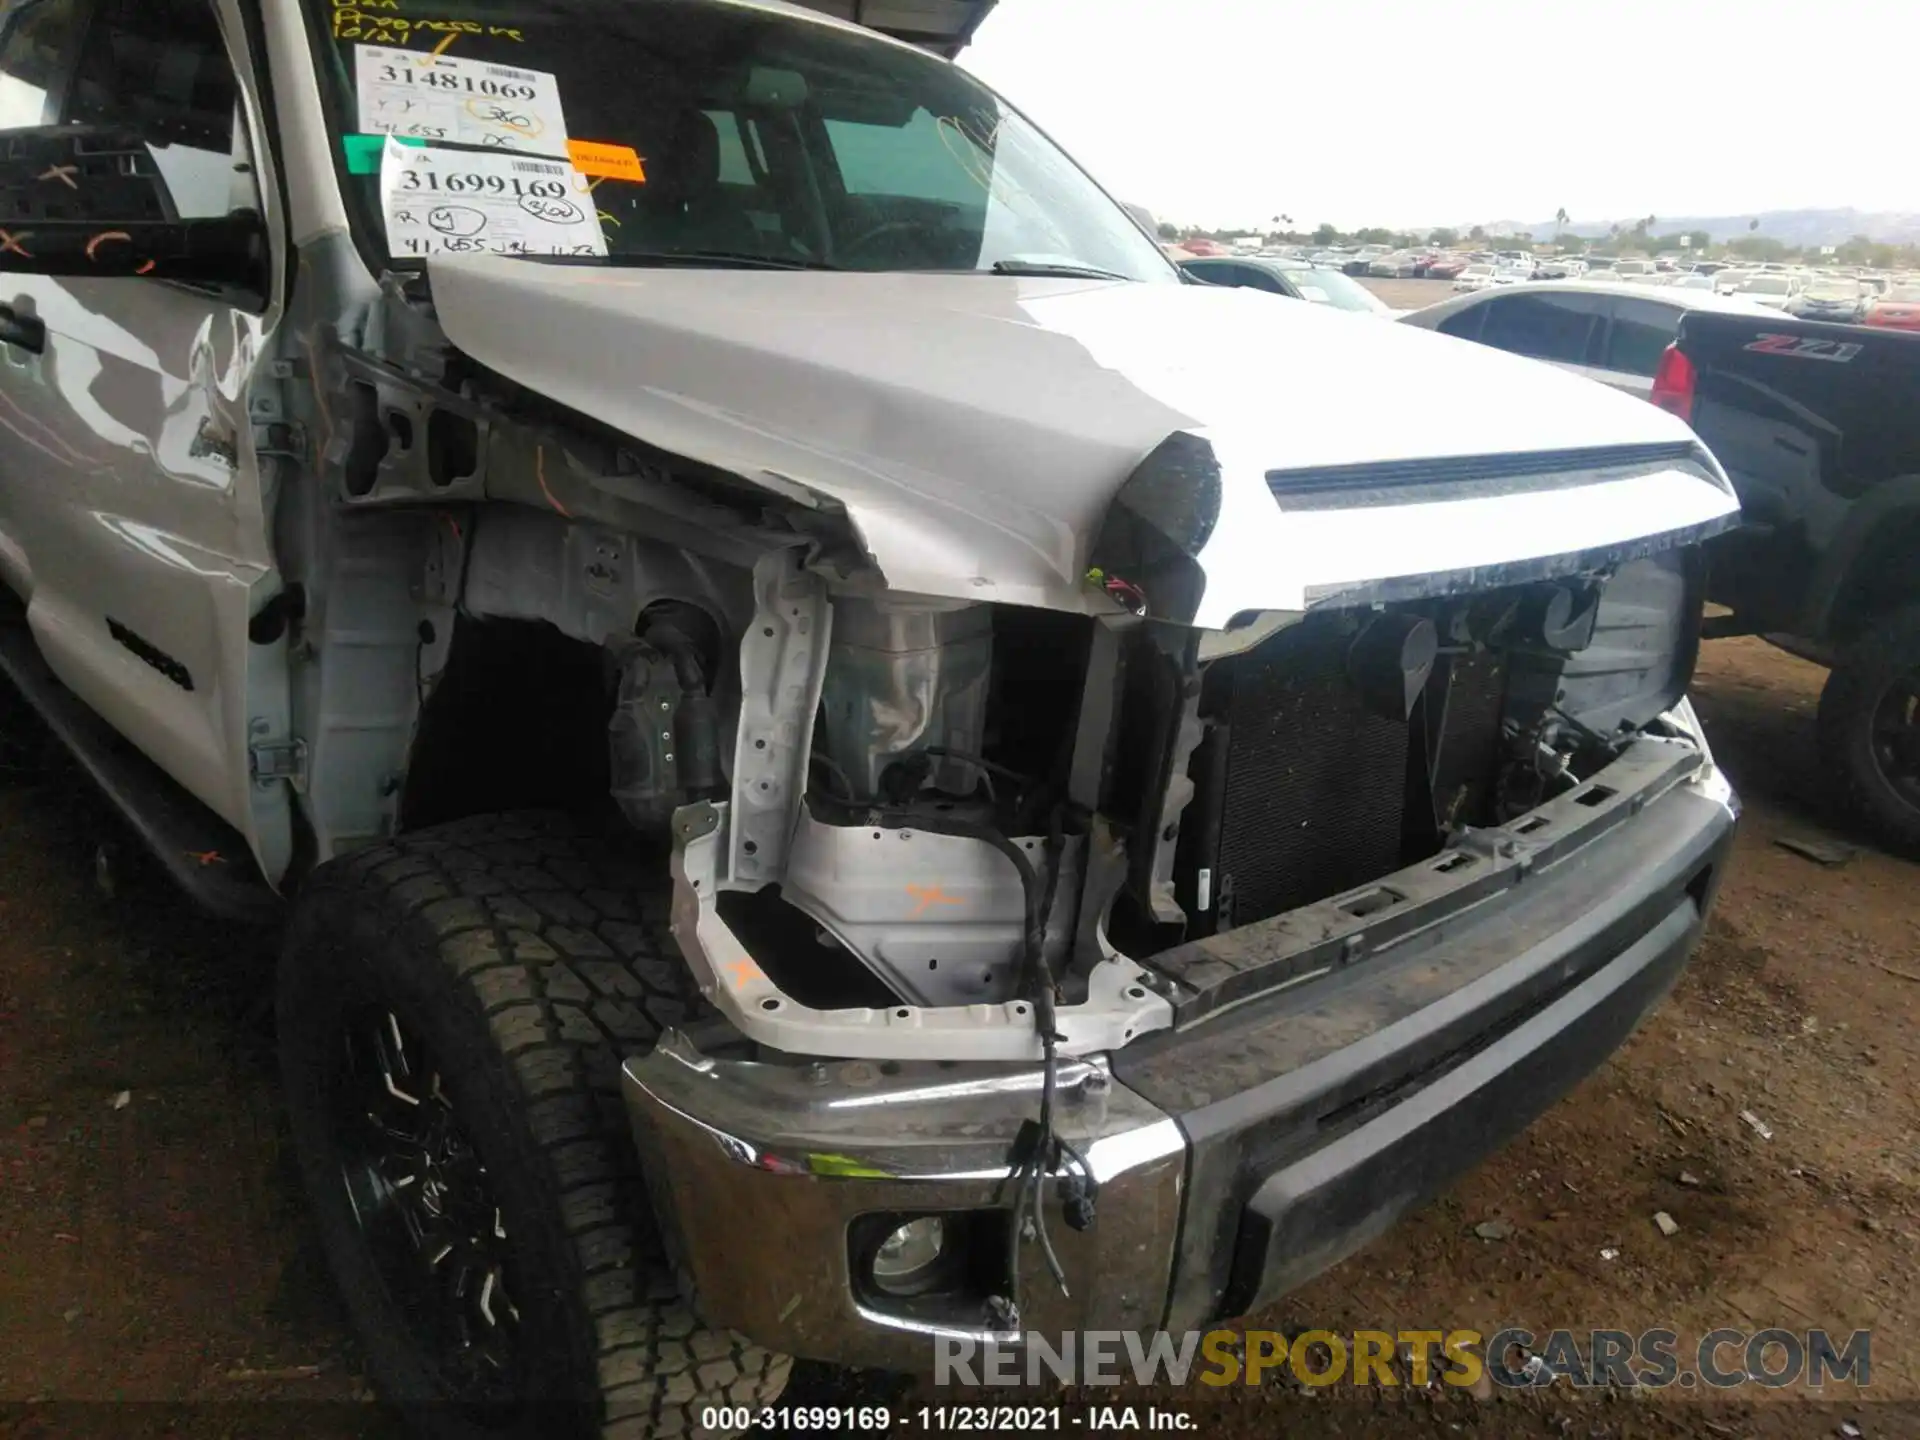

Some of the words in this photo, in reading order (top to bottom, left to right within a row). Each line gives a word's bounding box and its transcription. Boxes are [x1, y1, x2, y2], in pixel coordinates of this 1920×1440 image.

[379, 64, 537, 101] 31481069
[401, 169, 567, 199] 31699169
[1743, 332, 1865, 363] Z71
